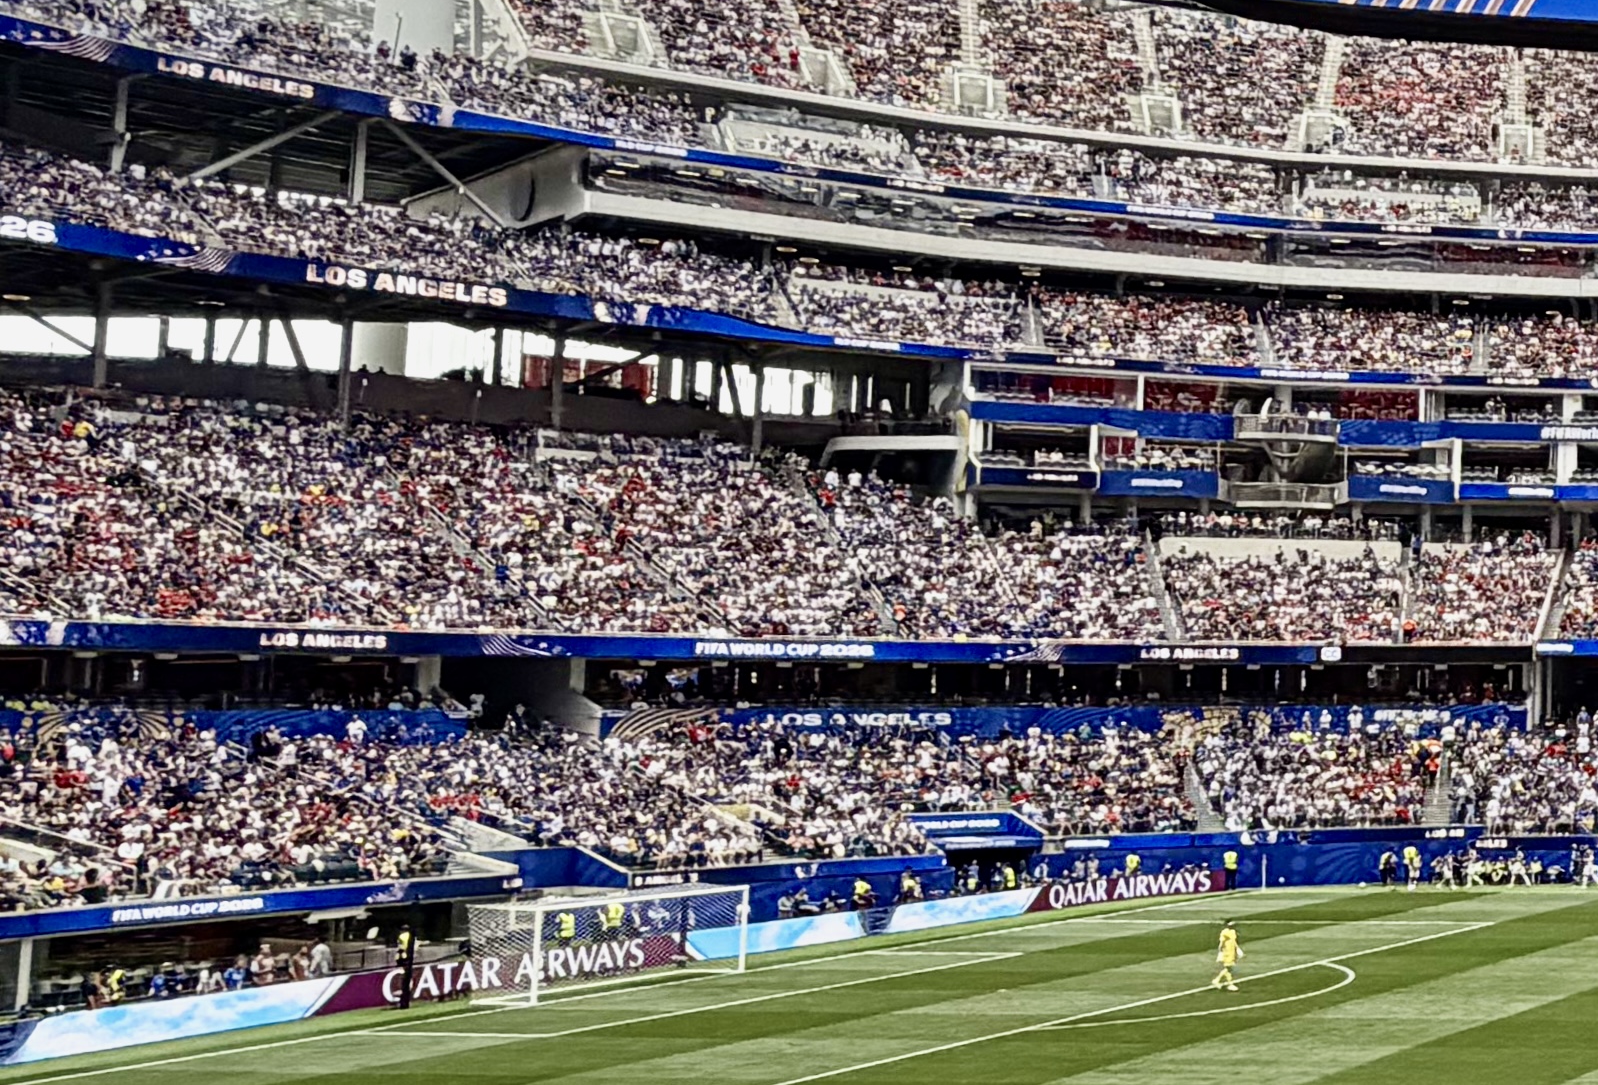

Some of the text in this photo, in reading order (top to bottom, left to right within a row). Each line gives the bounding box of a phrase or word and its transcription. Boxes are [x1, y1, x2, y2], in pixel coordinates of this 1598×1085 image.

[157, 57, 315, 99] LOS ANGELES
[306, 263, 508, 307] LOS ANGELES
[259, 633, 388, 649] LOS ANGELES
[695, 642, 729, 655] FIFA
[729, 642, 786, 656] WORLD
[786, 643, 819, 656] CUP
[1140, 648, 1240, 660] LOS ANGELES
[1049, 870, 1212, 909] QATAR AIRWAYS
[112, 909, 142, 922] FIFA
[142, 905, 190, 919] WORLD
[191, 902, 218, 915] CUP
